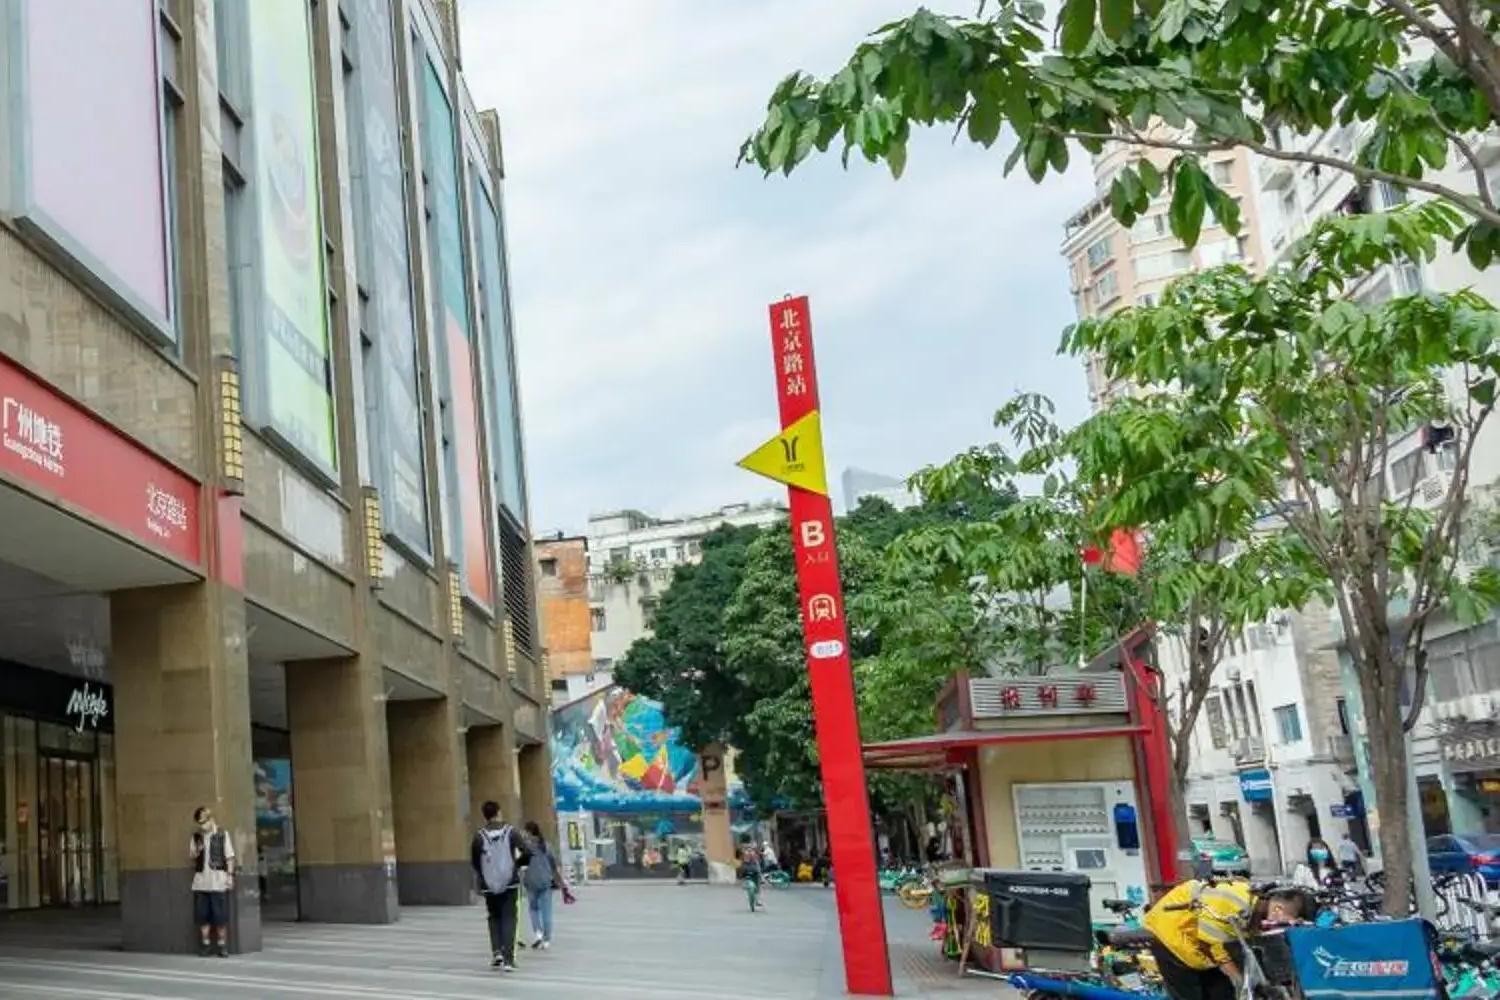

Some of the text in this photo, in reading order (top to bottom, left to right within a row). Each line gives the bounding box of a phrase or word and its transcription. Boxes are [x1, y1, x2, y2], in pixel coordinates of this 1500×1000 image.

[779, 308, 807, 396] 北京路站
[3, 396, 64, 461] 广州地铁
[145, 480, 188, 531] 北京路站
[801, 520, 825, 547] B
